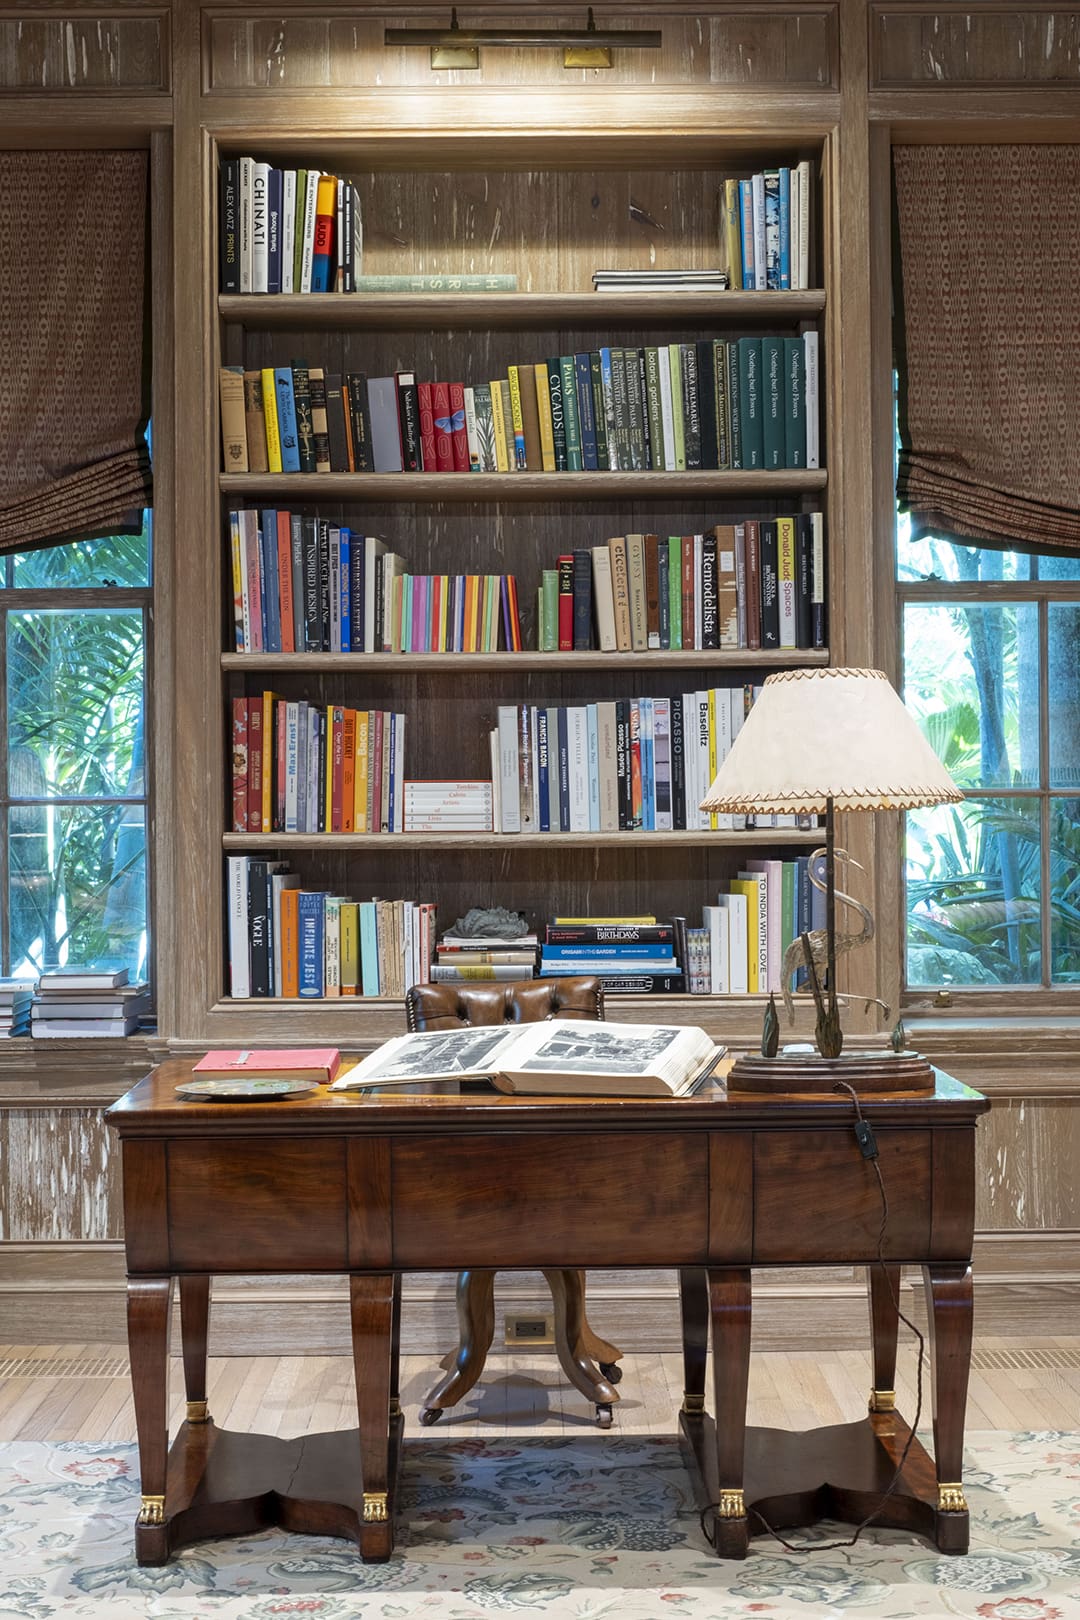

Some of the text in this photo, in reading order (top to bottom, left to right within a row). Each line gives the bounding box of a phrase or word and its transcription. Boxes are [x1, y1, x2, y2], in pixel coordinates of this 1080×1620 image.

[254, 178, 264, 246] CHINATI
[318, 221, 327, 247] JUDD
[411, 279, 498, 289] HIRST
[564, 364, 575, 396] PALMS
[748, 349, 756, 378] (Nothing
[770, 349, 778, 378] (Nothing
[791, 349, 800, 378] (Nothing
[612, 361, 622, 404] CULTIVATED
[626, 361, 635, 404] CULTIVATED
[648, 352, 660, 422] botanic gardens
[688, 351, 698, 433] GENERA PALMARUM
[718, 382, 724, 392] OF
[512, 394, 522, 429] HOCKNEY
[550, 375, 564, 430] CYCADS
[792, 393, 800, 418] Flowers
[404, 390, 416, 452] Nabokov's Butterflies
[466, 411, 476, 434] Florida
[292, 522, 302, 542] Jaime
[782, 524, 790, 557] Donald
[320, 551, 328, 580] BEACH
[614, 546, 627, 598] etcetera
[632, 544, 641, 580] GYPSY
[306, 544, 318, 622] INSPIRED DESIGN
[352, 549, 362, 632] NATURE'S PALETTE
[702, 552, 716, 633] Remodelista
[782, 582, 792, 617] Spaces
[252, 712, 260, 730] OBEY
[673, 700, 682, 754] PICASSO
[700, 702, 710, 747] Baselitz
[344, 719, 354, 759] DAVID HOCKNEY
[358, 724, 367, 756] Bacon
[760, 878, 766, 890] TO
[252, 916, 266, 946] VOGUE
[596, 931, 640, 940] BIRTHDAYS
[304, 918, 315, 984] INFINITE JEST
